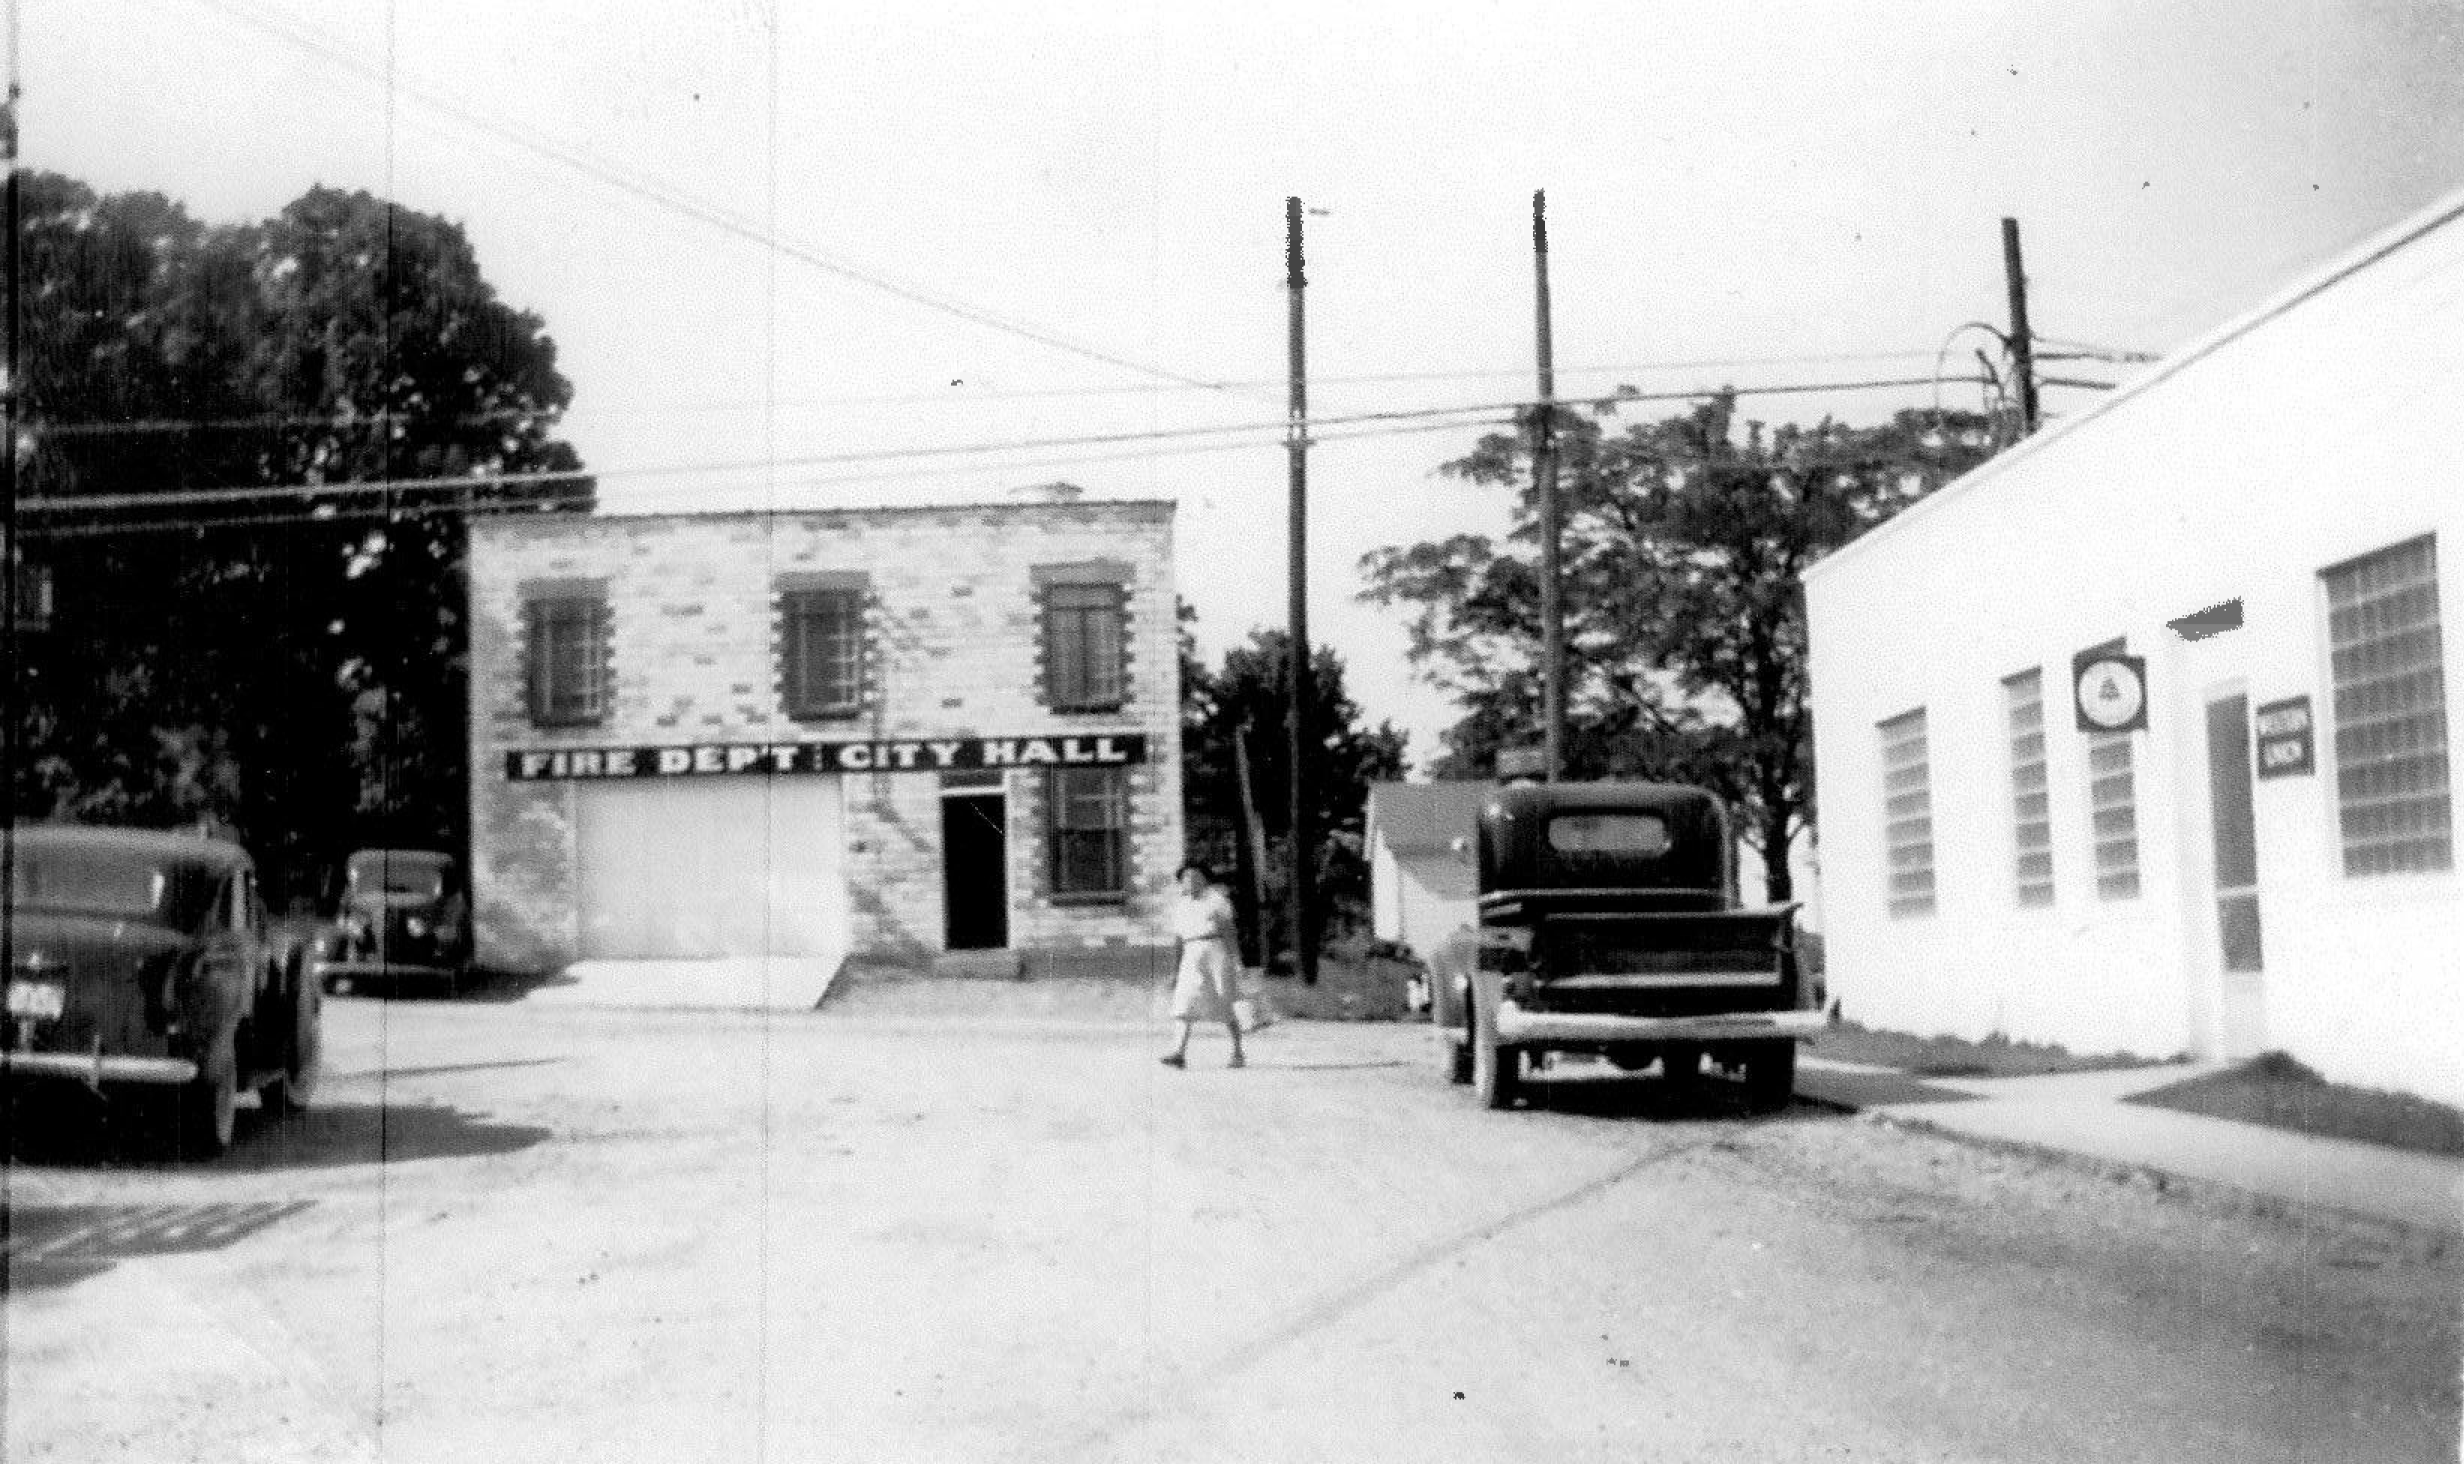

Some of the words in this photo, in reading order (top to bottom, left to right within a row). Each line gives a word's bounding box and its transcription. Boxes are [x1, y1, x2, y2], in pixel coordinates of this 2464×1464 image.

[522, 751, 637, 776] FIRE
[838, 742, 960, 768] CITY
[983, 738, 1127, 764] HALL
